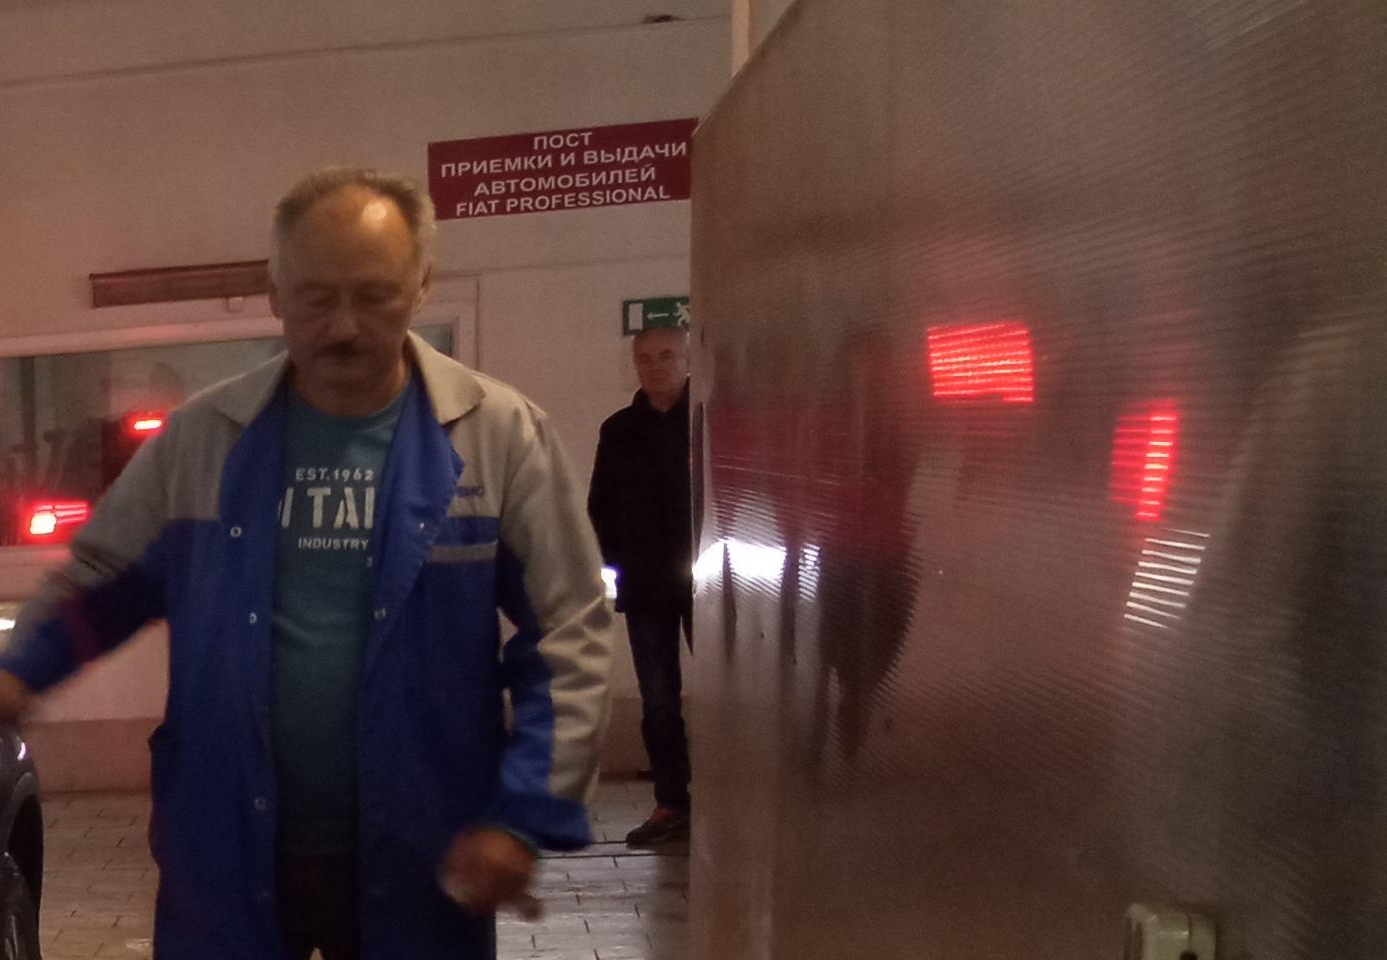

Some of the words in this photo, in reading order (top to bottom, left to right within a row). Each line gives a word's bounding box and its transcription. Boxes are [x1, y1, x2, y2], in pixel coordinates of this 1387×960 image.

[533, 131, 594, 151] ПОСТ
[440, 152, 554, 178] ПРИЕМКИ
[560, 151, 576, 167] И
[583, 141, 688, 165] ВЫДАЧИ
[474, 164, 656, 197] АВТОМОБИЛЕЙ
[455, 199, 500, 217] FIAT
[505, 185, 671, 213] PROFESSIONAL
[298, 537, 369, 551] INDUSTRY
